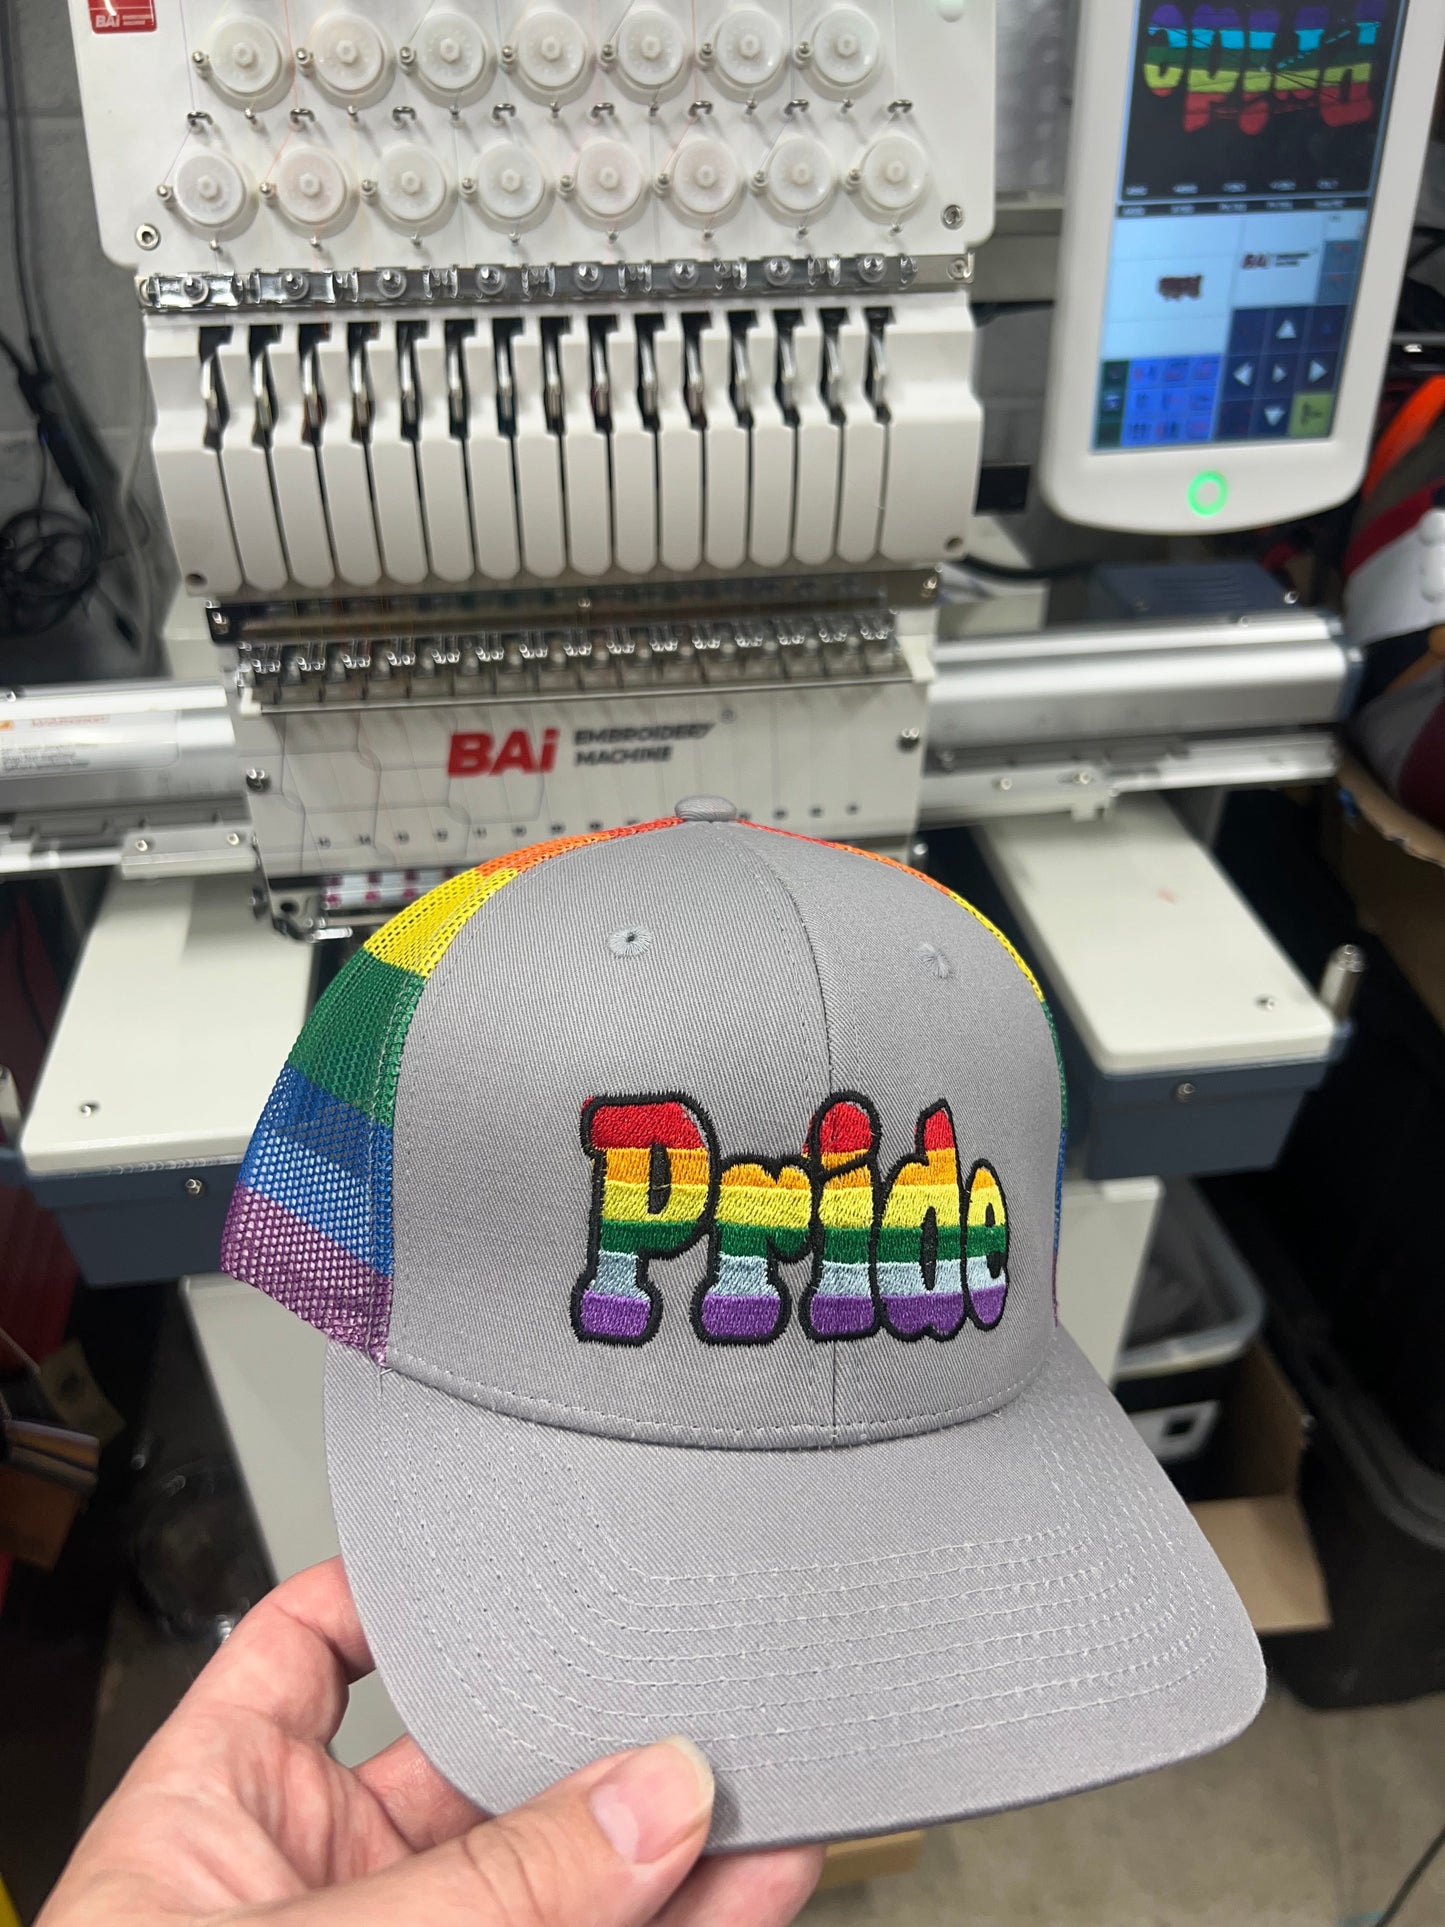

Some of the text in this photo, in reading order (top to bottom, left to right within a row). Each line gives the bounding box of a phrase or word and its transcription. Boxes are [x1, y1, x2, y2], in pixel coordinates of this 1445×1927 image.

[447, 727, 560, 776] BAi
[574, 722, 716, 745] EMBROIDERY
[574, 746, 673, 766] MACHINE
[571, 1089, 1010, 1346] Pride
